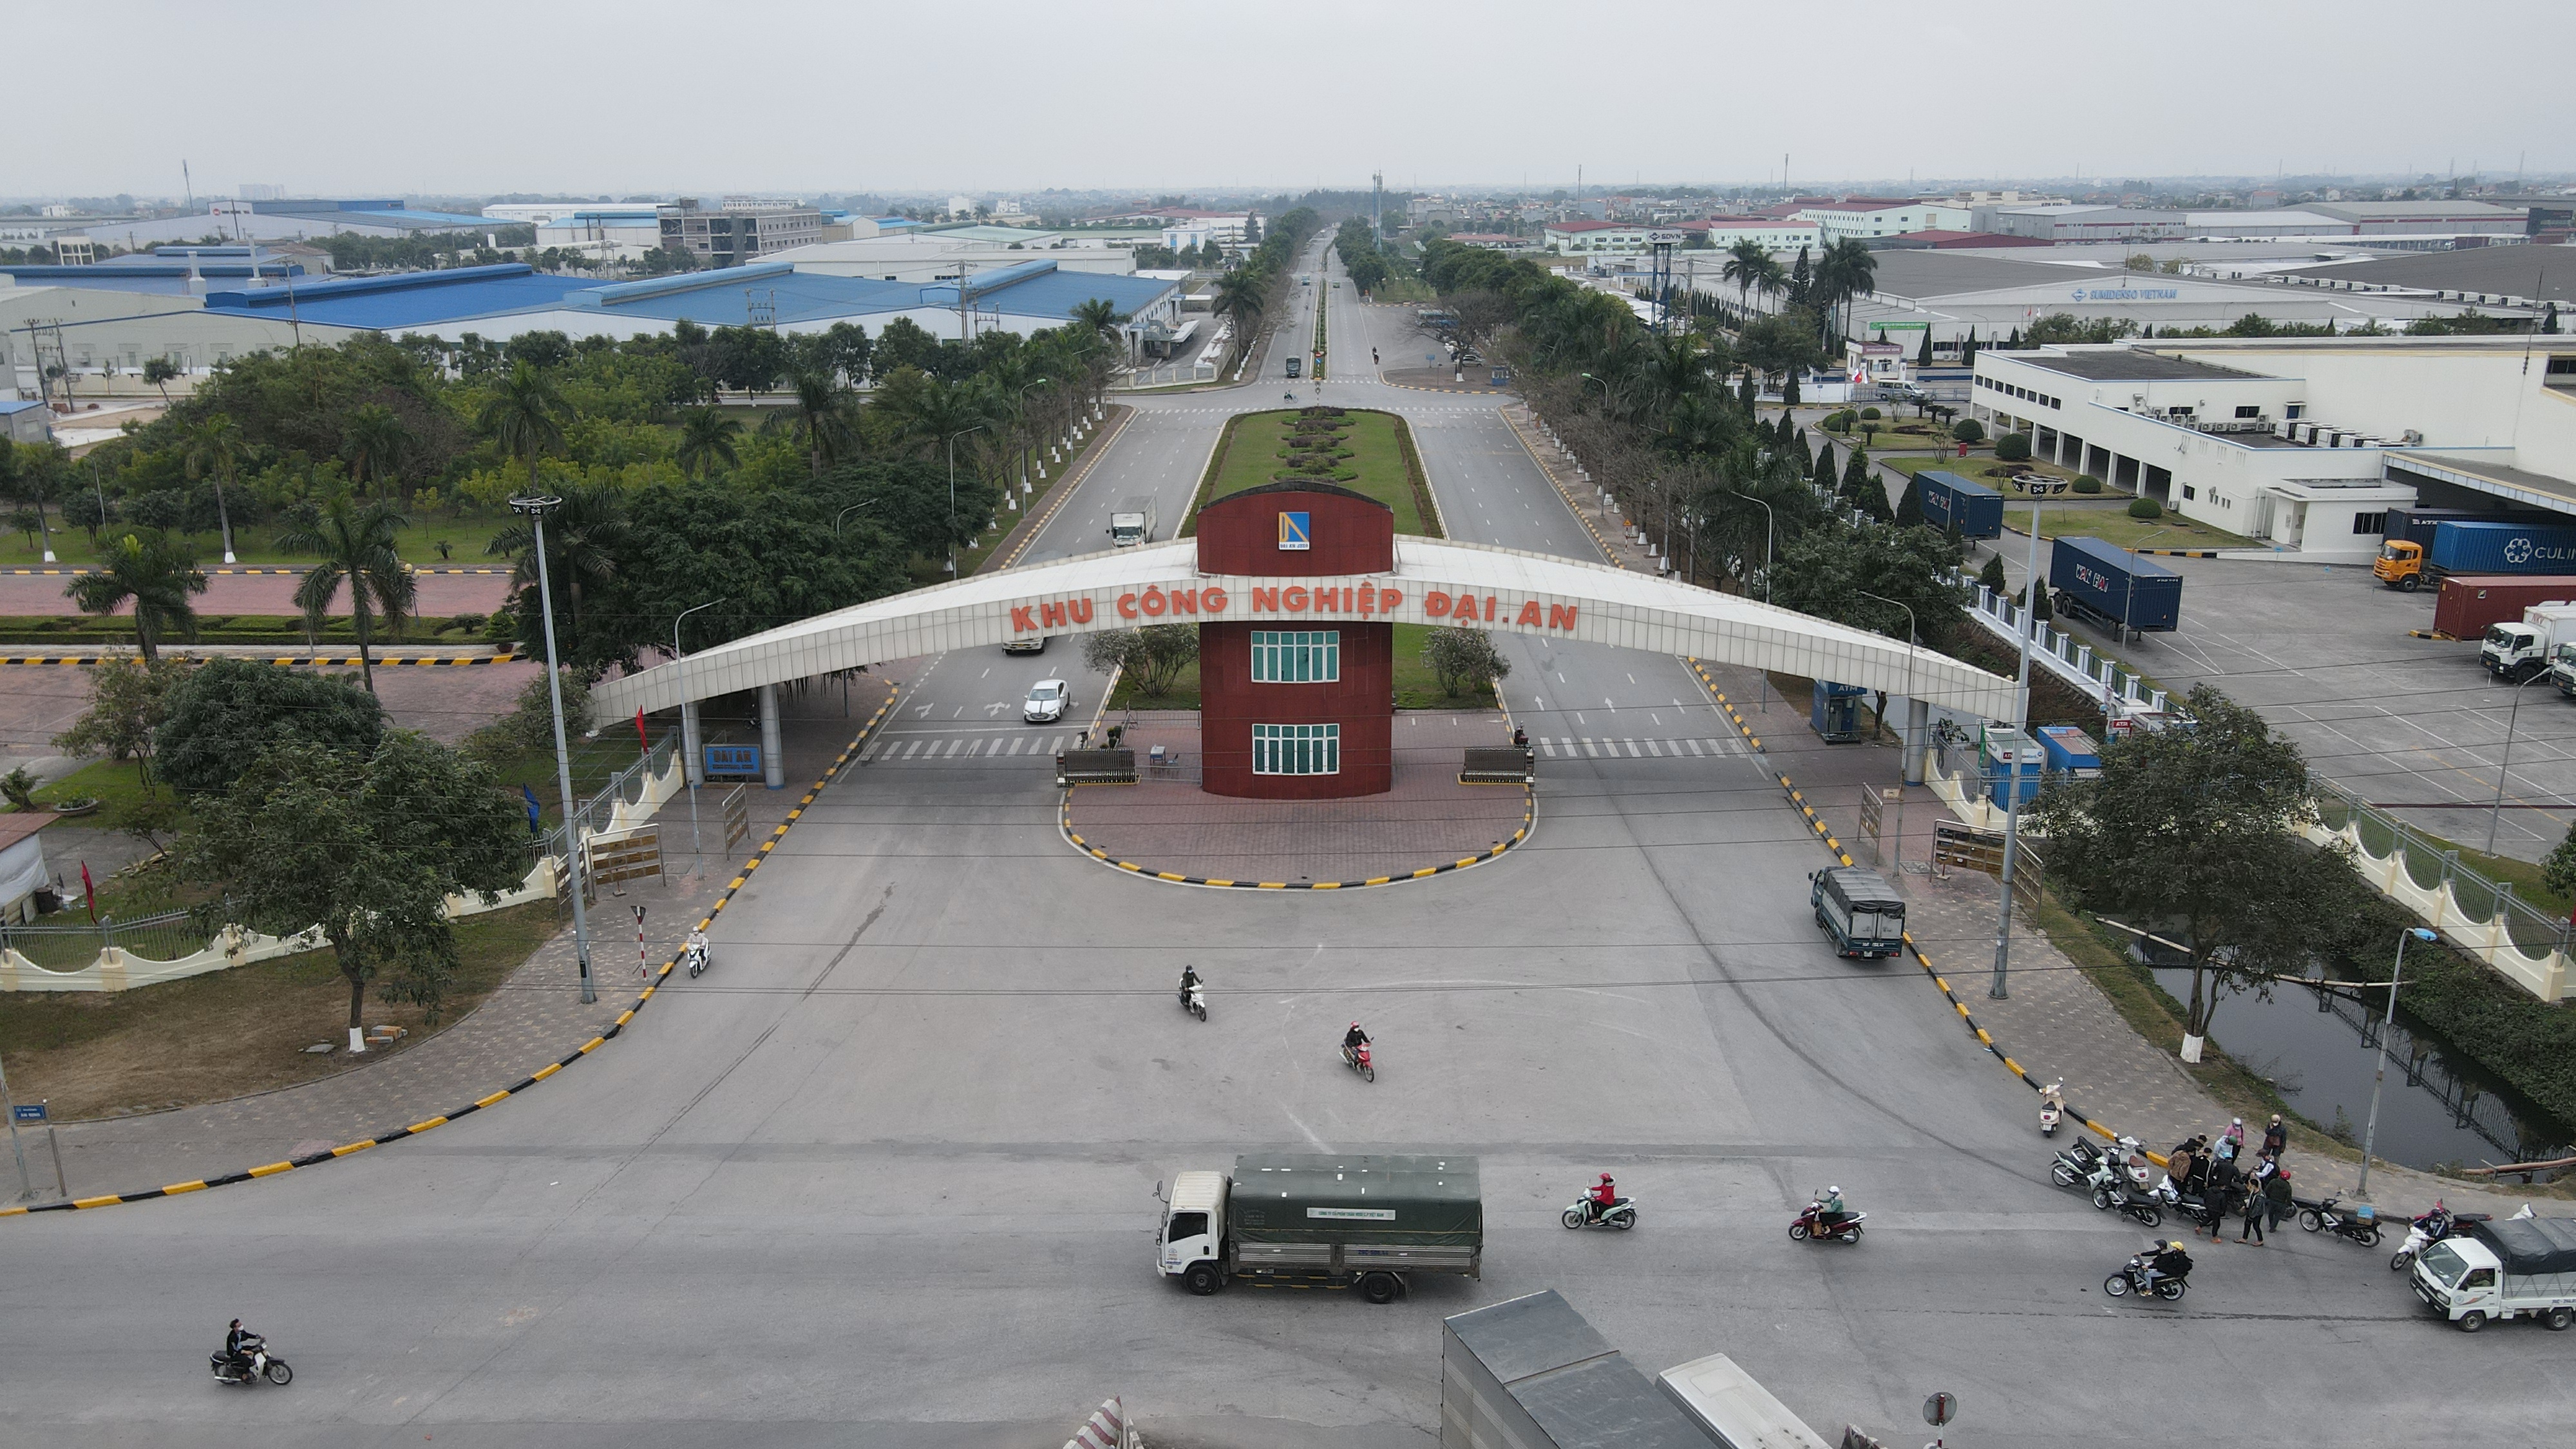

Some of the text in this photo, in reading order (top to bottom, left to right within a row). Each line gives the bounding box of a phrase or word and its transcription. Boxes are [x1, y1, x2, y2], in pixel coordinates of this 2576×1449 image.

[2090, 289, 2177, 299] SUMIDENSO VIETNAM
[1010, 598, 1093, 632] KHU
[1117, 583, 1227, 619] CÔNG
[1253, 582, 1403, 620] NGHIỆP
